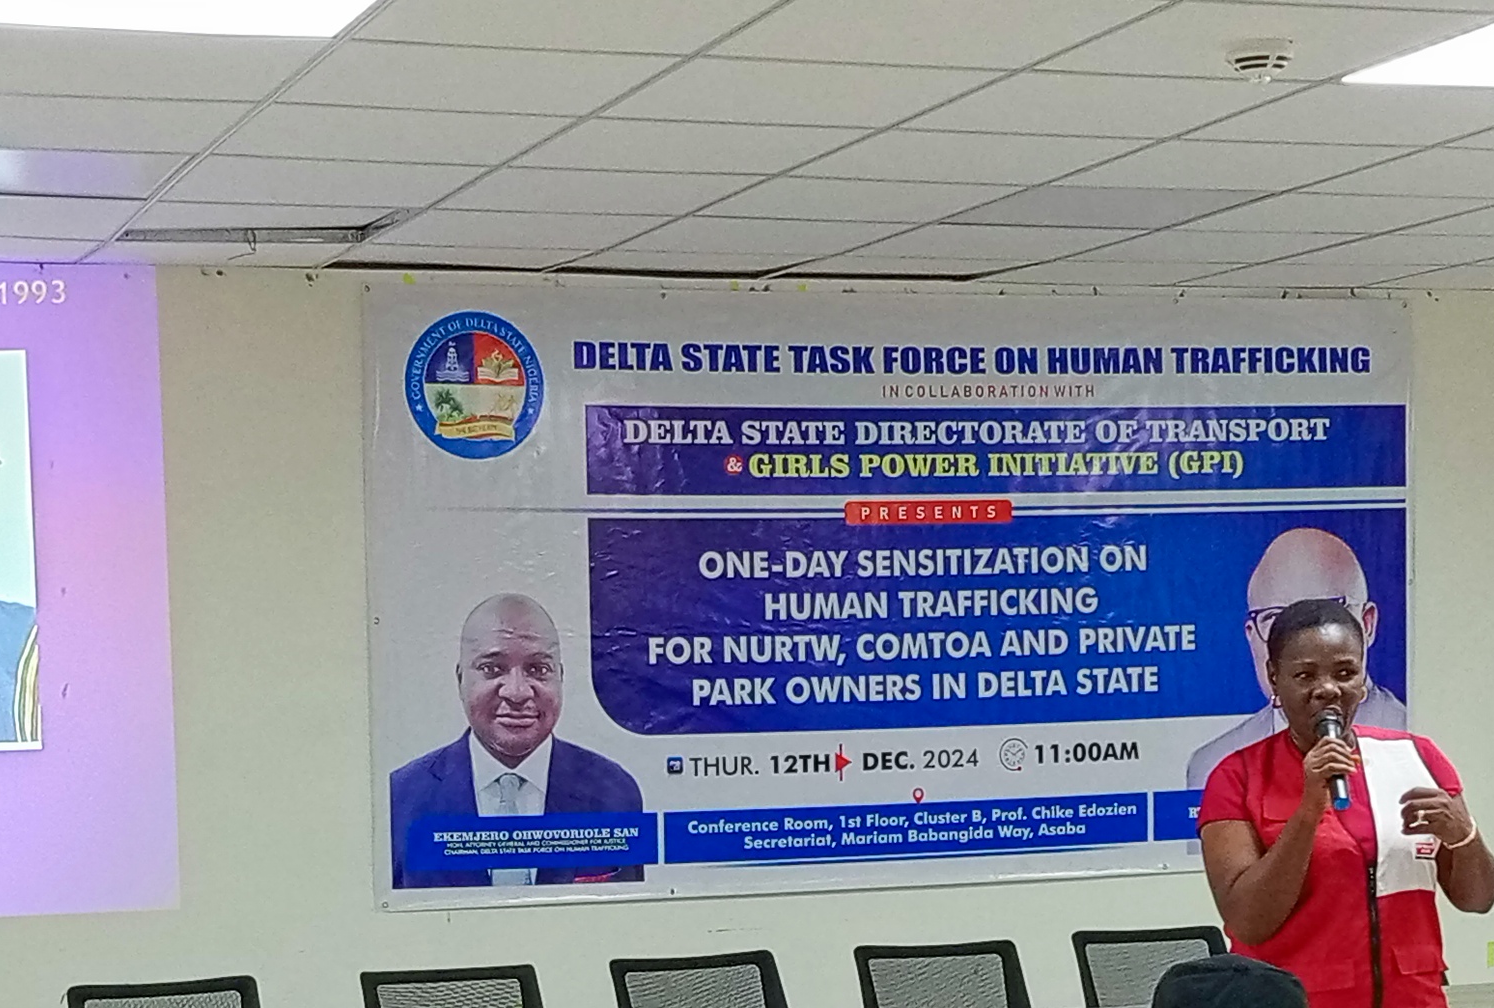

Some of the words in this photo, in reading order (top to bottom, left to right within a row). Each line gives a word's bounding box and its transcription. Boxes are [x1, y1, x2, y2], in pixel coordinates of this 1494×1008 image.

[411, 326, 447, 400] GOVERNMENT
[448, 320, 463, 333] OF
[465, 317, 498, 333] DELTA
[499, 328, 526, 357] STATE
[523, 356, 541, 402] NIGERIA
[573, 340, 672, 371] DELTA
[681, 342, 780, 373] STATE
[787, 344, 876, 375] TASK
[883, 347, 986, 376] FORCE
[994, 346, 1044, 375] ON
[1047, 346, 1164, 375] HUMAN
[1171, 346, 1372, 374] TRAFFICKING
[881, 385, 900, 399] IN
[904, 384, 1050, 399] COLLABORATION
[1054, 384, 1096, 398] WITH
[623, 420, 733, 444] DELTA
[740, 421, 846, 445] STATE
[854, 420, 1086, 445] DIRECTORATE
[1095, 420, 1140, 444] OF
[1145, 418, 1331, 443] TRANSPORT
[727, 456, 744, 474] &
[749, 454, 850, 478] GIRLS
[859, 454, 980, 478] POWER
[987, 452, 1159, 476] INITIATIVE
[1169, 450, 1244, 479] (GPI)
[861, 506, 999, 520] PRESENTS
[697, 550, 852, 580] ONE-DAY
[858, 546, 1091, 577] SENSITIZATION
[1101, 545, 1148, 573] ON
[764, 593, 888, 621] HUMAN
[899, 587, 1099, 619] TRAFFICKING
[648, 637, 713, 666] FOR
[723, 634, 847, 667] NURTW,
[856, 630, 993, 660] COMTOA
[999, 628, 1070, 657] AND
[1078, 625, 1196, 653] PRIVATE
[693, 678, 776, 706] PARK
[785, 674, 921, 703] OWNERS
[932, 672, 968, 699] IN
[977, 670, 1068, 698] DELTA
[1075, 667, 1159, 694] STATE
[690, 756, 760, 778] THUR.
[769, 754, 830, 774] 12TH
[862, 750, 915, 772] DEC.
[923, 749, 980, 769] 2024
[1035, 741, 1139, 765] 11:00AM
[614, 827, 639, 838] SAN
[688, 819, 779, 835] Conference
[783, 815, 833, 832] Room,
[839, 814, 862, 829] 1st
[866, 812, 909, 828] Floor,
[914, 810, 968, 826] Cluster
[971, 810, 987, 825] B,
[992, 806, 1027, 822] Prof.
[1031, 805, 1074, 820] Chike
[1078, 802, 1137, 819] Edozien
[744, 832, 837, 850] Secretariat,
[841, 830, 903, 846] Mariam
[908, 826, 994, 845] Babangida
[996, 824, 1034, 841] Way,
[1038, 822, 1086, 837] Asaba
